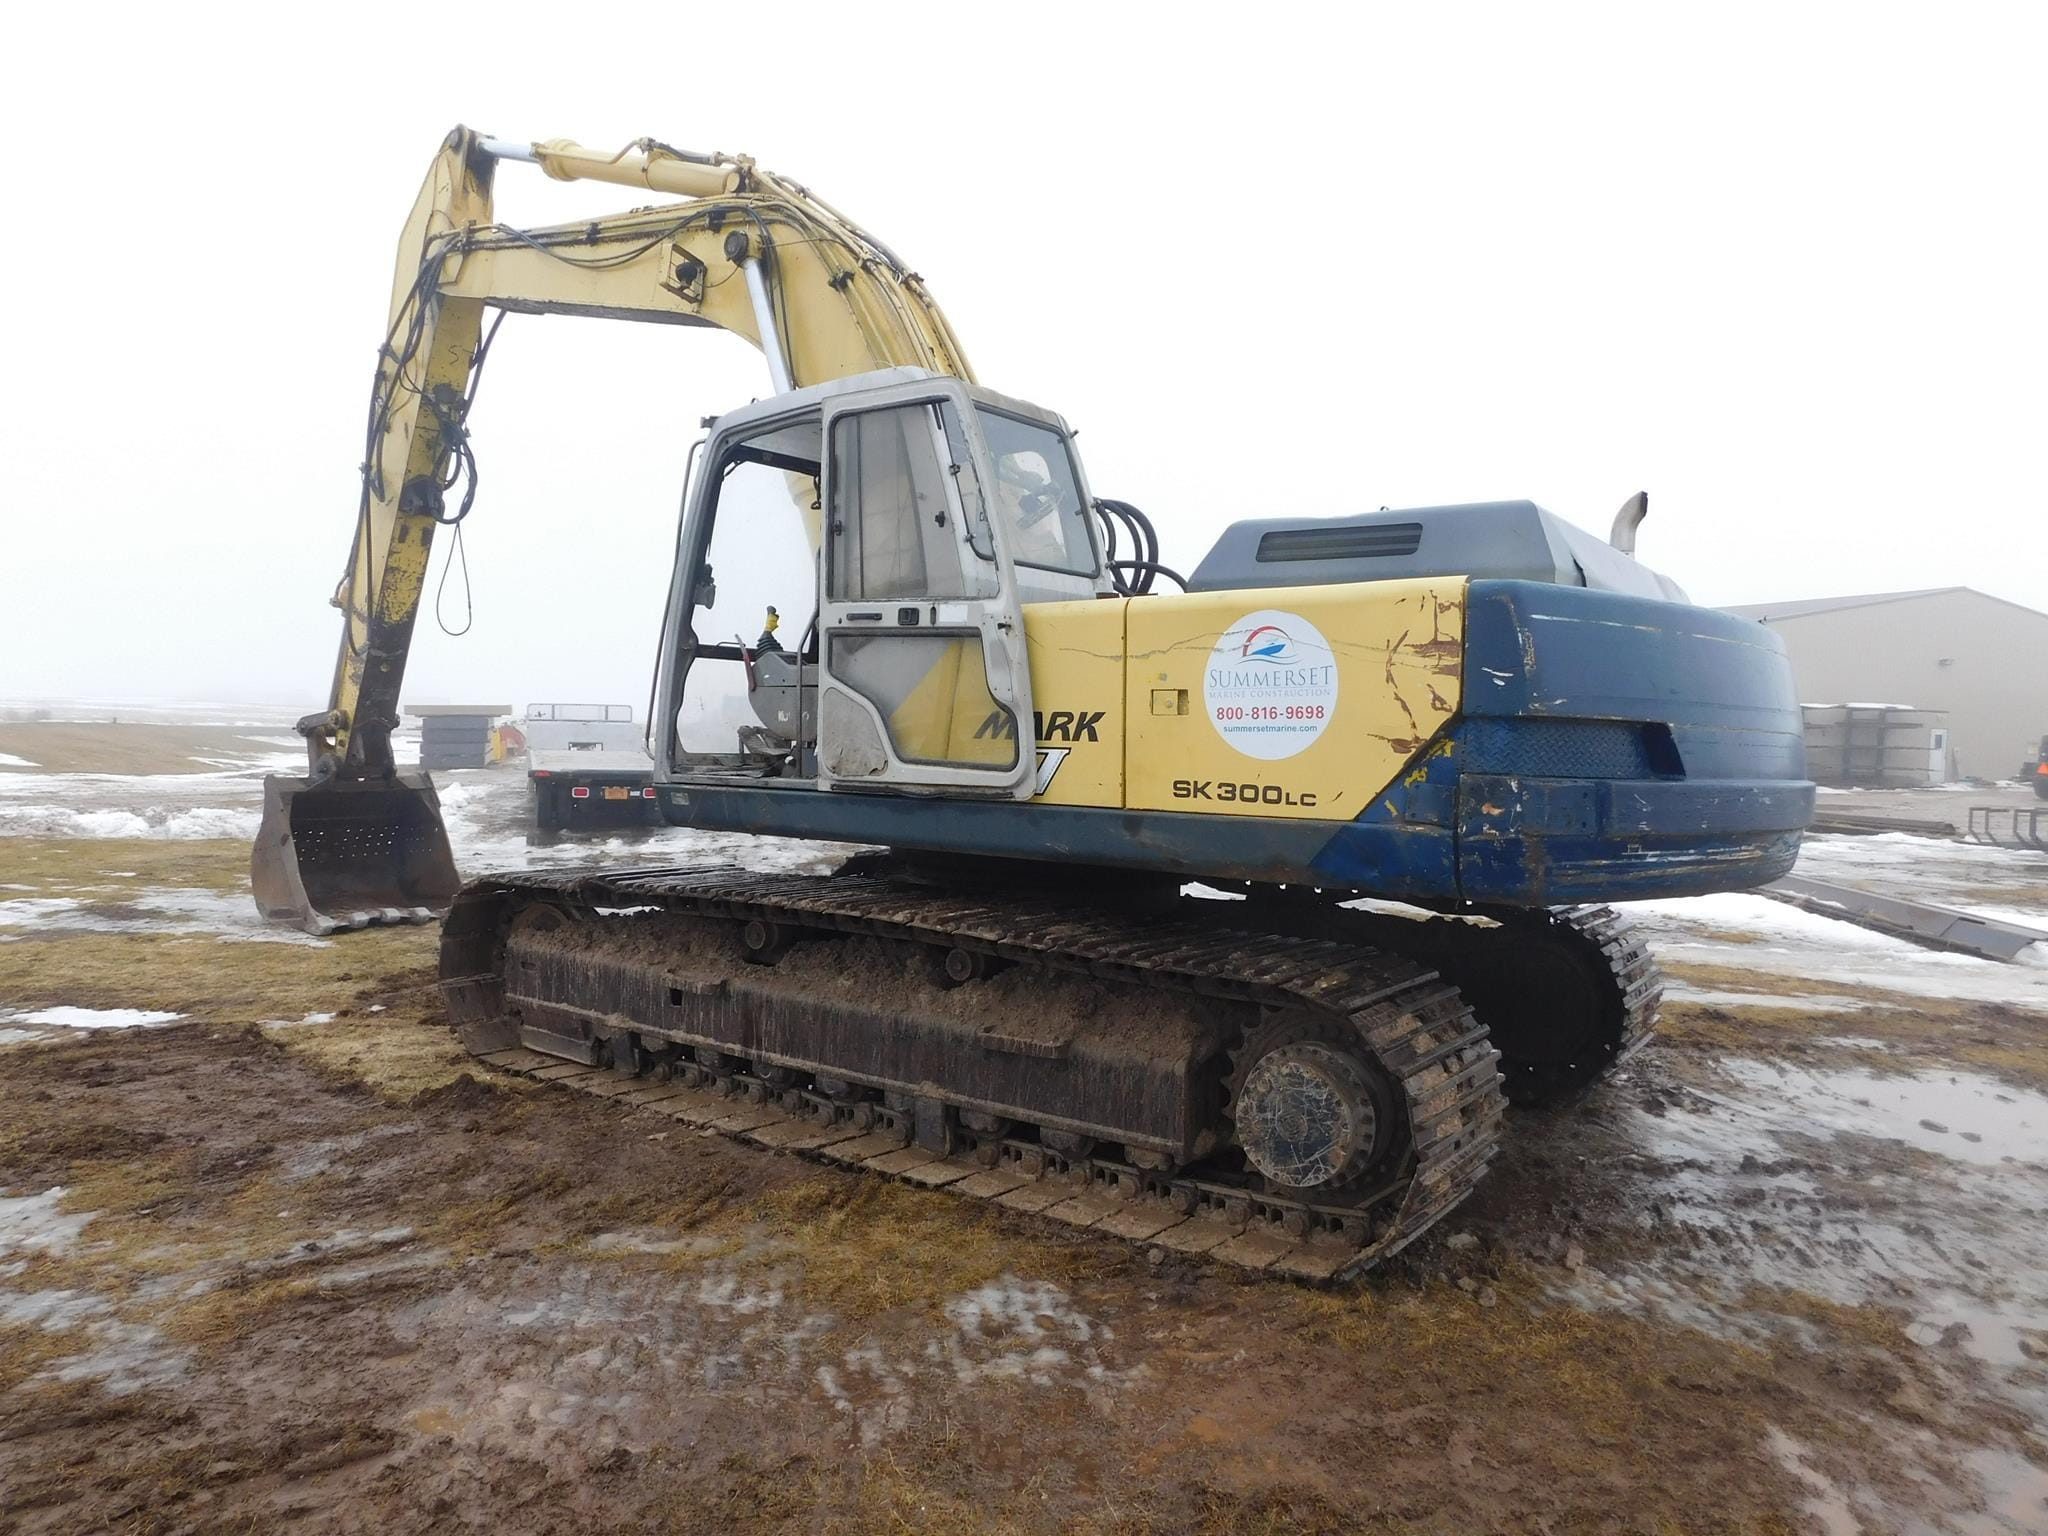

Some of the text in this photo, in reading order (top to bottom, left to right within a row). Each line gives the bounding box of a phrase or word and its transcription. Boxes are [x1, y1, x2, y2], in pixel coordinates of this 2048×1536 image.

[1208, 665, 1334, 689] SUMMERSET
[1208, 687, 1331, 699] MARINE CONSTRUCTION
[1215, 705, 1325, 721] 800-816-9698
[1222, 724, 1318, 733] summersetmarine.com
